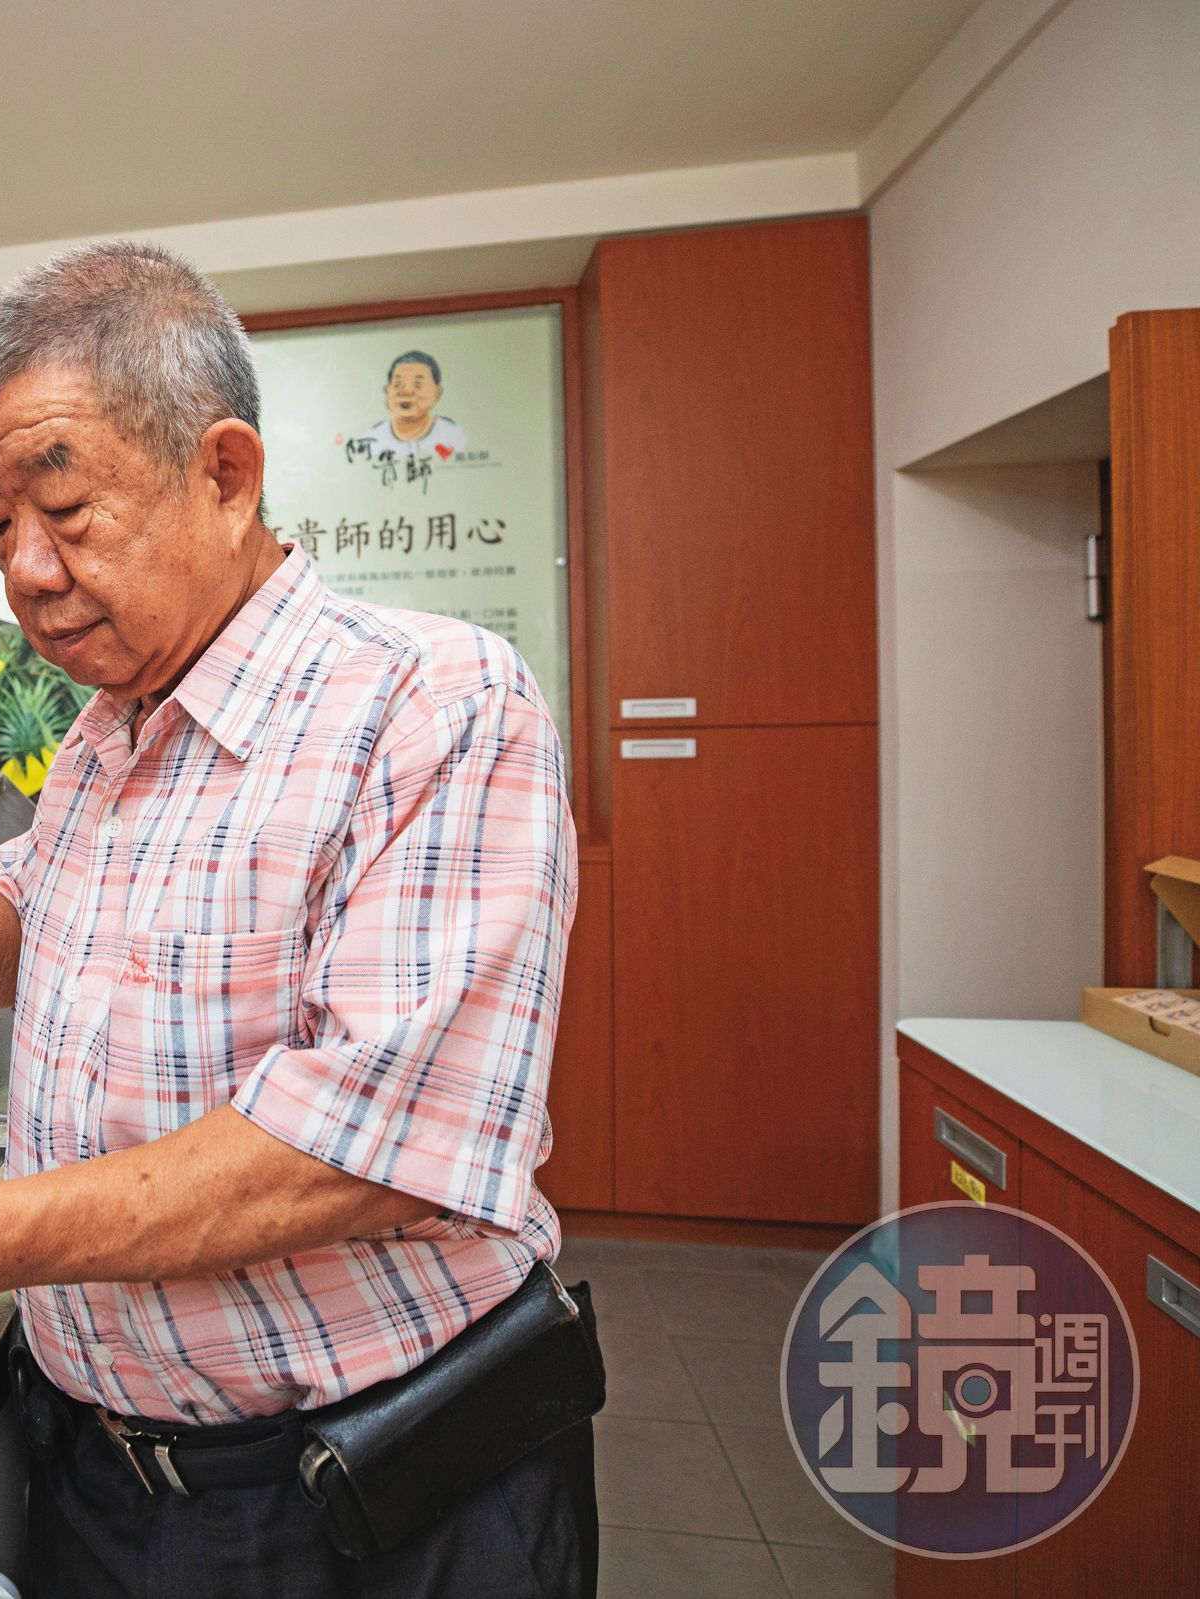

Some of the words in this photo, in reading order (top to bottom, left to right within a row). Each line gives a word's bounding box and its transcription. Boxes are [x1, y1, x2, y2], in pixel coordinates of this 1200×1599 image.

[273, 512, 506, 561] 貴師的用心
